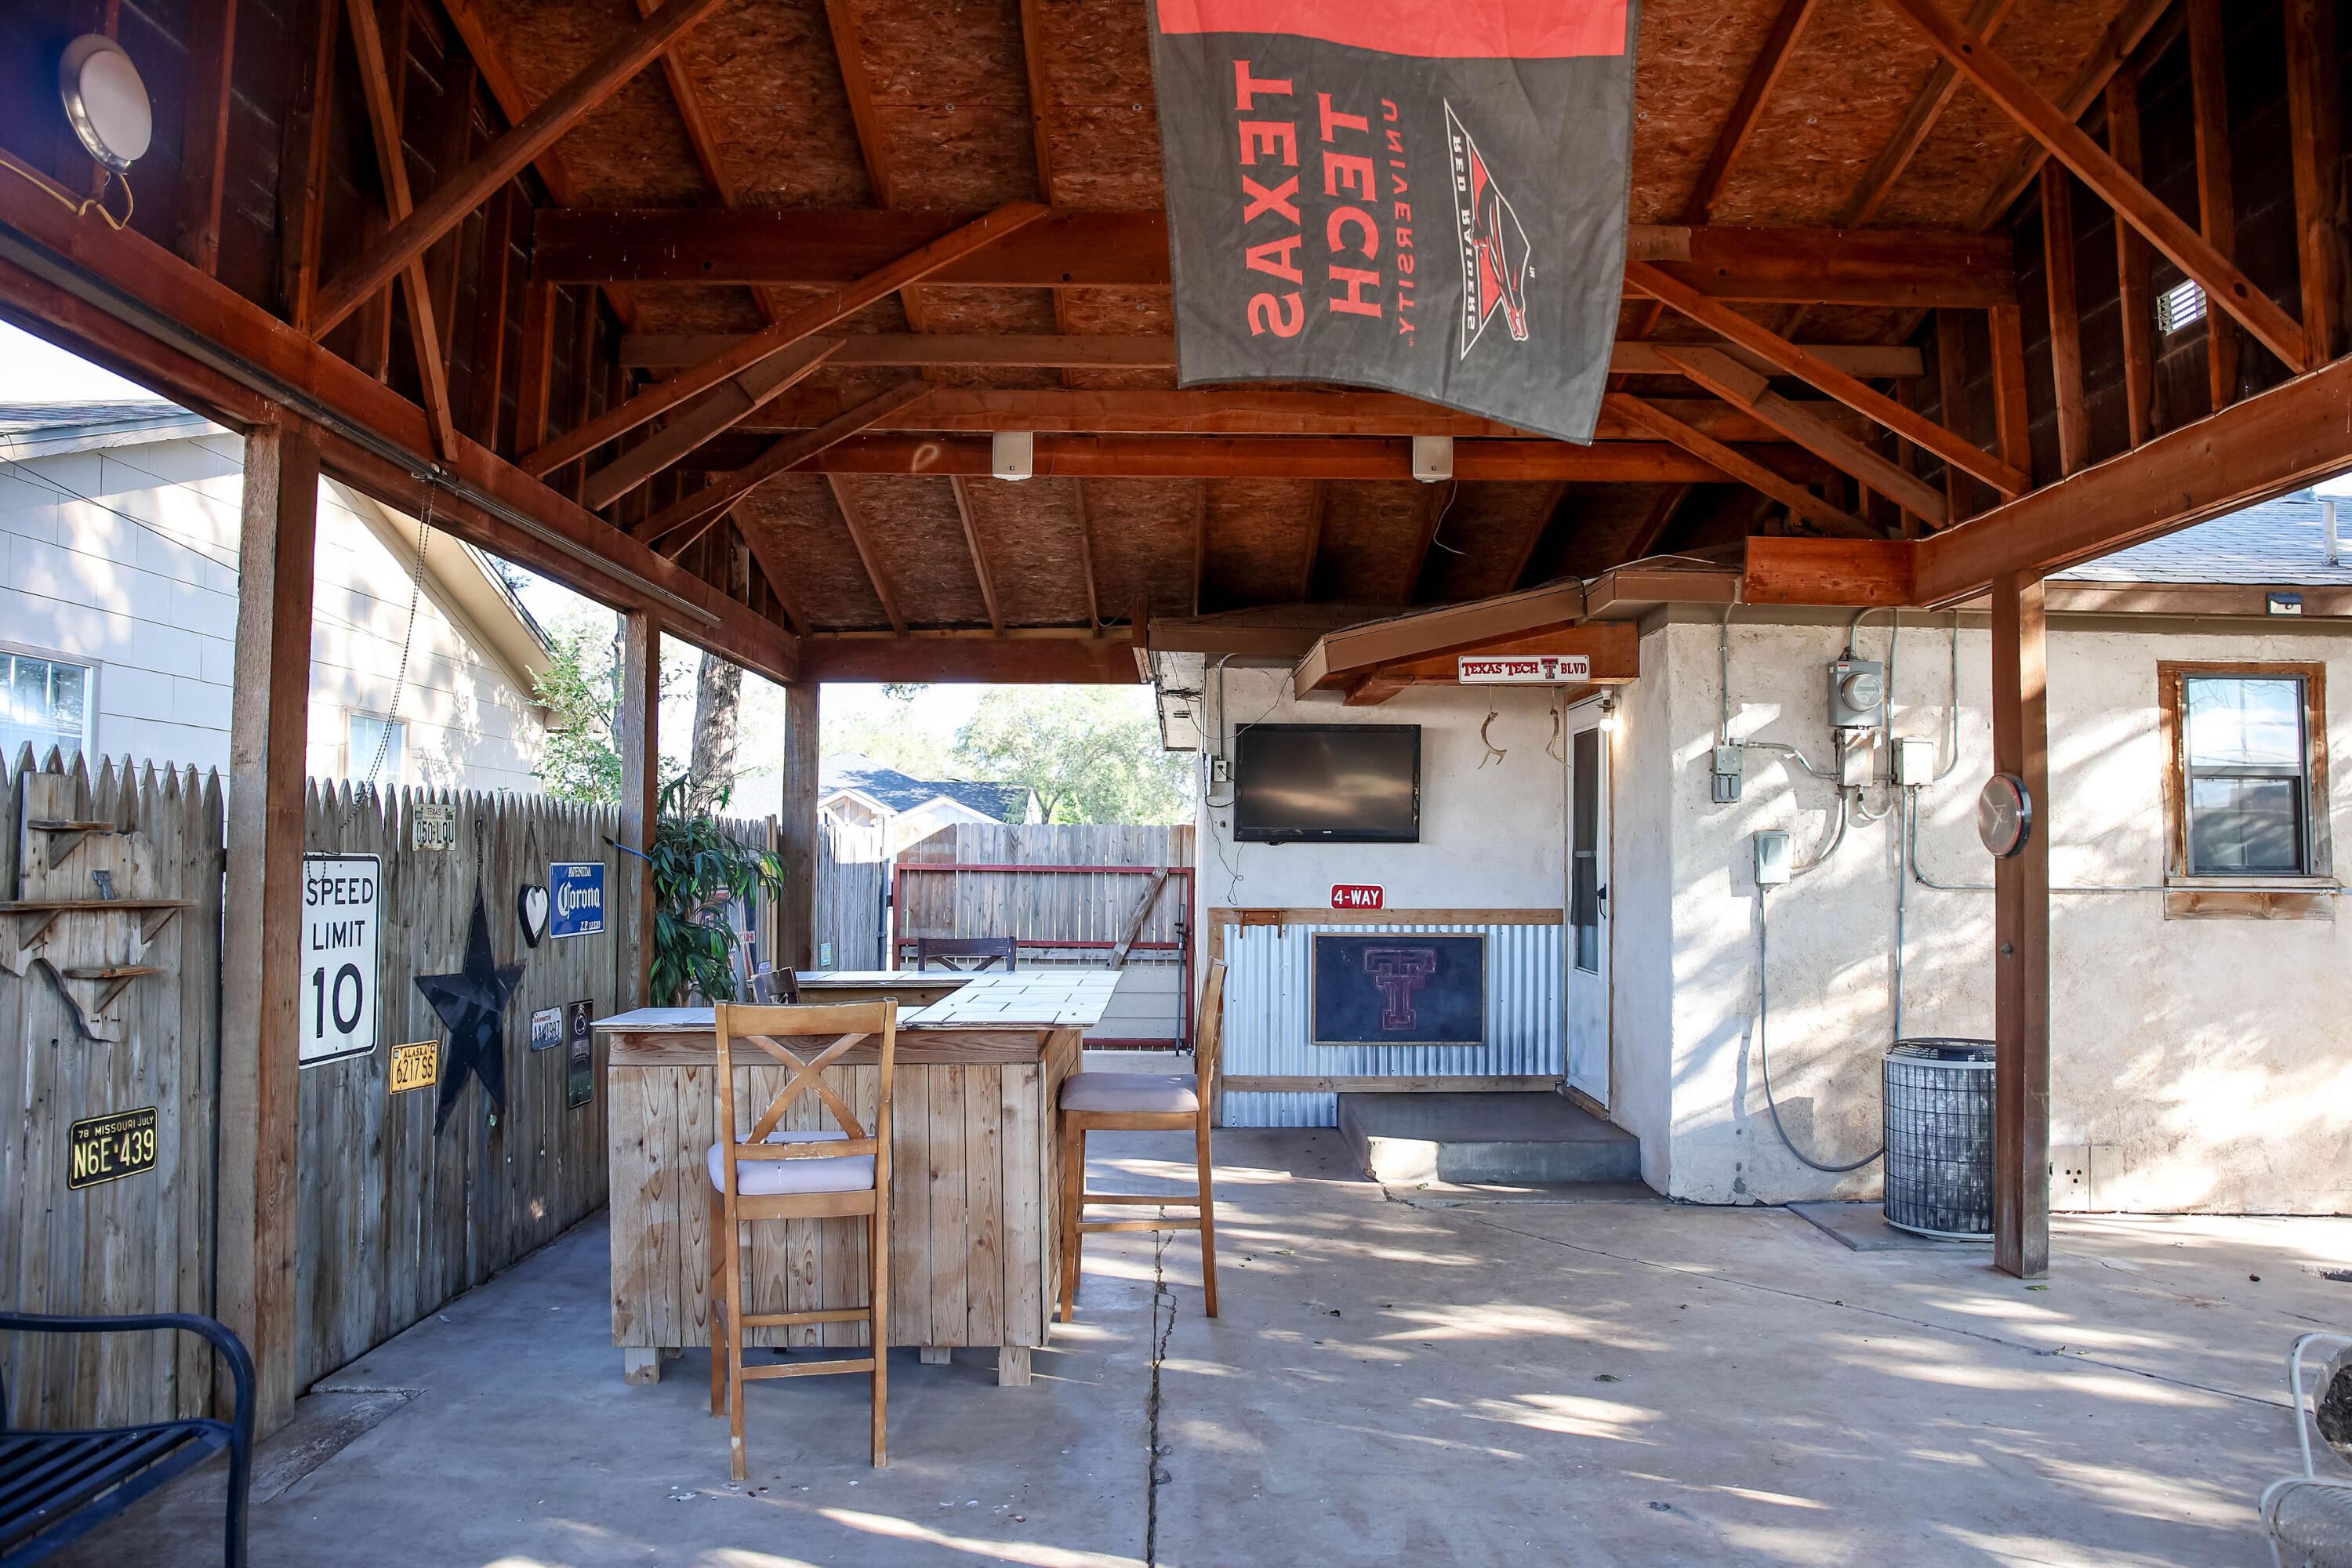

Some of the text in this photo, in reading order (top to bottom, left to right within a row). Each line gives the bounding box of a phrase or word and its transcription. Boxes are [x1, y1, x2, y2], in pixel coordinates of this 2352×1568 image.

[1462, 662, 1504, 676] TEXAS
[1505, 662, 1539, 676] TECH
[1560, 662, 1587, 674] BLVD
[427, 808, 441, 816] TEXAS
[568, 866, 592, 877] AVENIDA
[306, 877, 374, 906] SPEED
[557, 880, 601, 920] Corona
[1333, 889, 1380, 906] 4-WAY
[313, 920, 365, 951] LIMIT
[312, 963, 363, 1039] 10
[403, 1047, 428, 1058] ALASKA
[78, 1116, 154, 1139] 78 MISSOURI JULY
